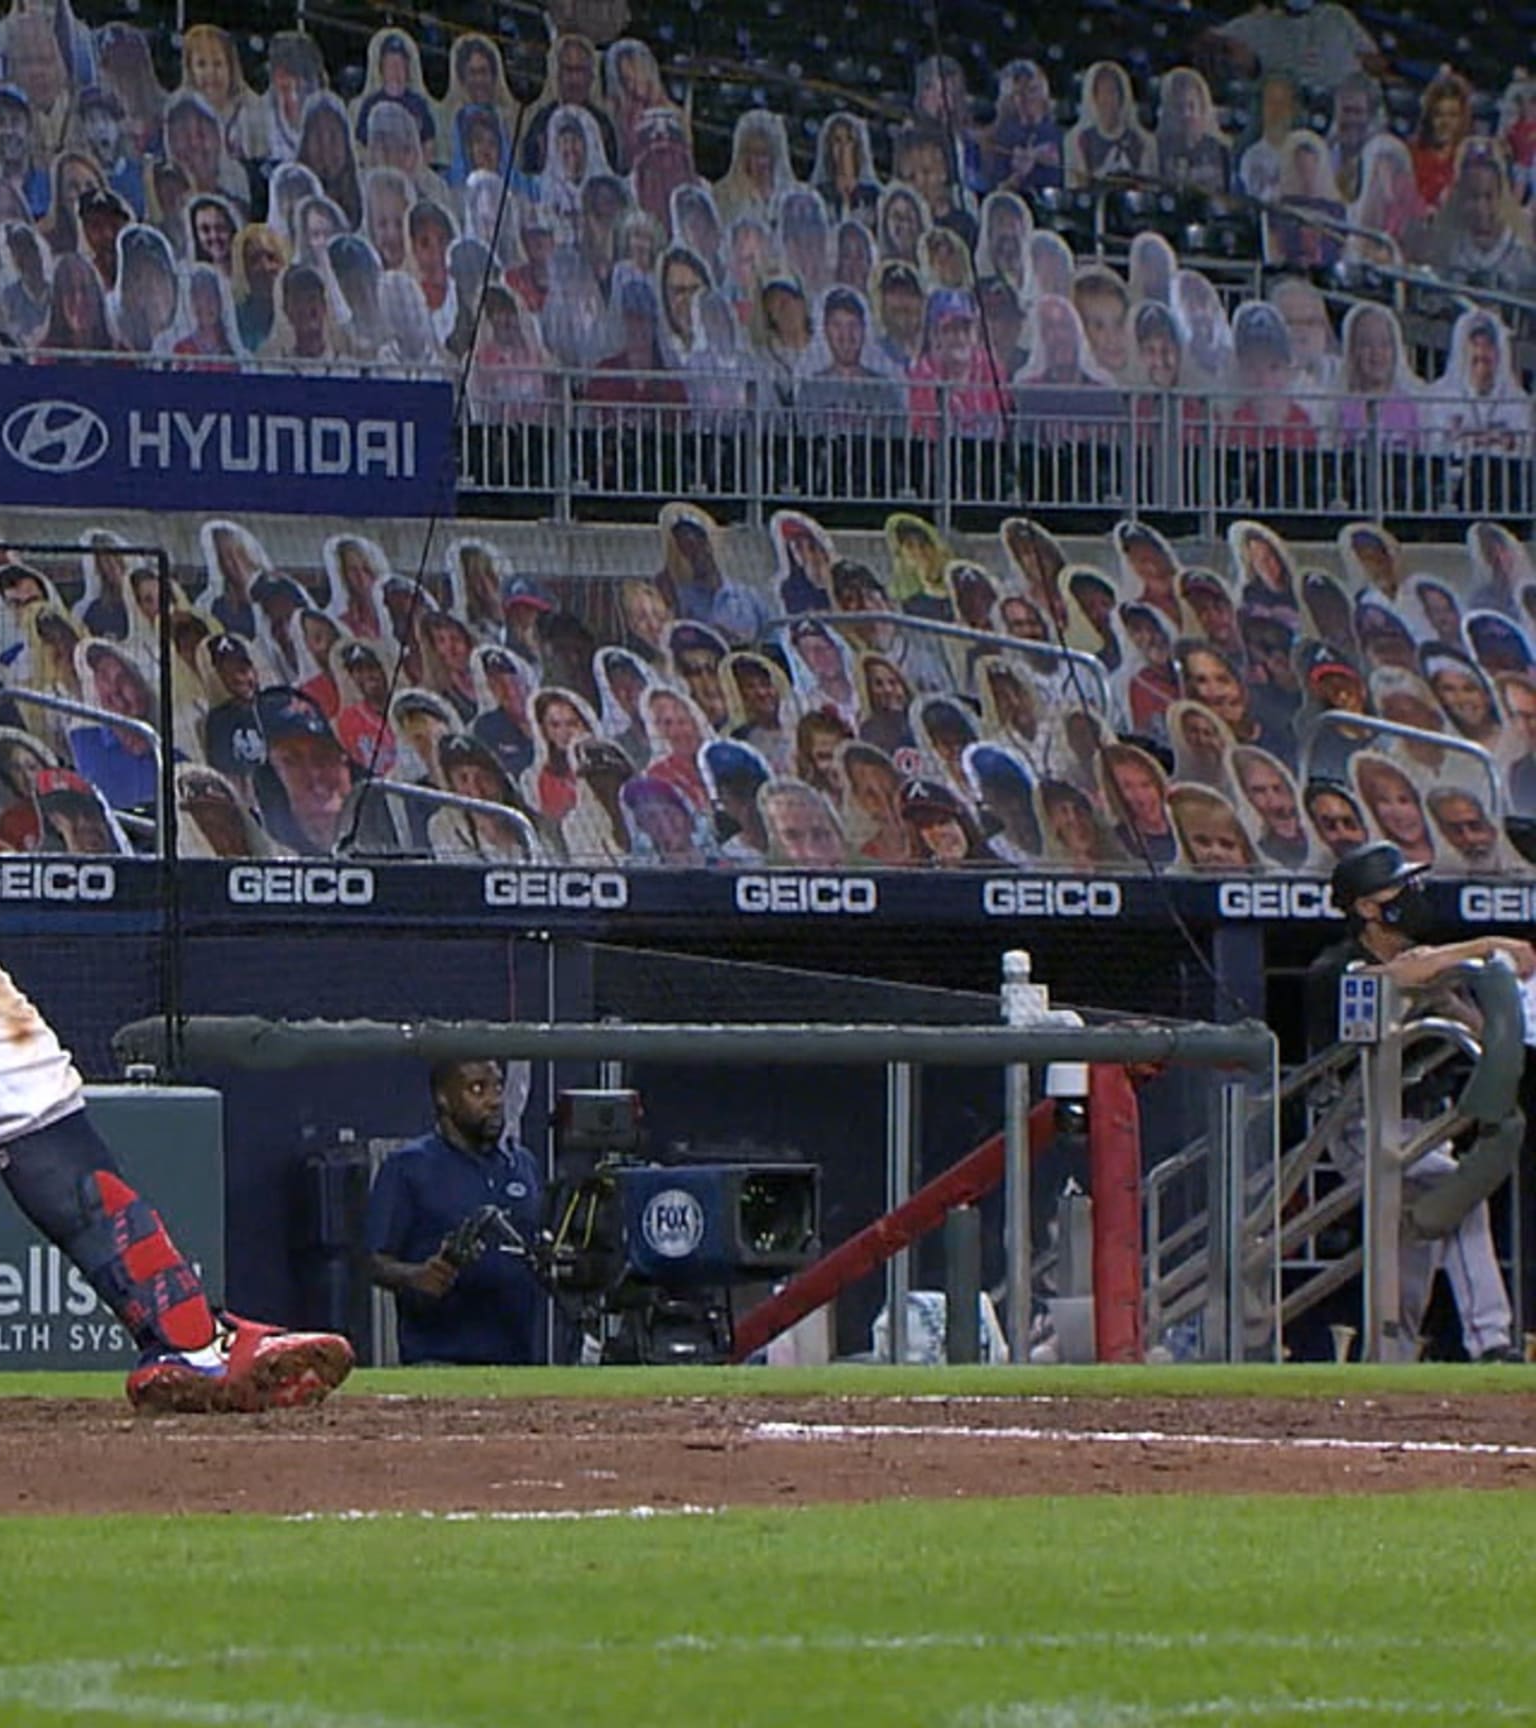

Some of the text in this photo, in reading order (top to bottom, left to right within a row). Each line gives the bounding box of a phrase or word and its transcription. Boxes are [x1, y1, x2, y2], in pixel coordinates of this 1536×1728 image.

[128, 410, 415, 478] HYUNDAI
[228, 867, 375, 904] GEICO
[484, 871, 628, 908] GEICO
[736, 876, 877, 912] GEICO
[984, 880, 1122, 916] GEICO
[1460, 885, 1536, 922] GEI
[656, 1203, 690, 1230] FOX
